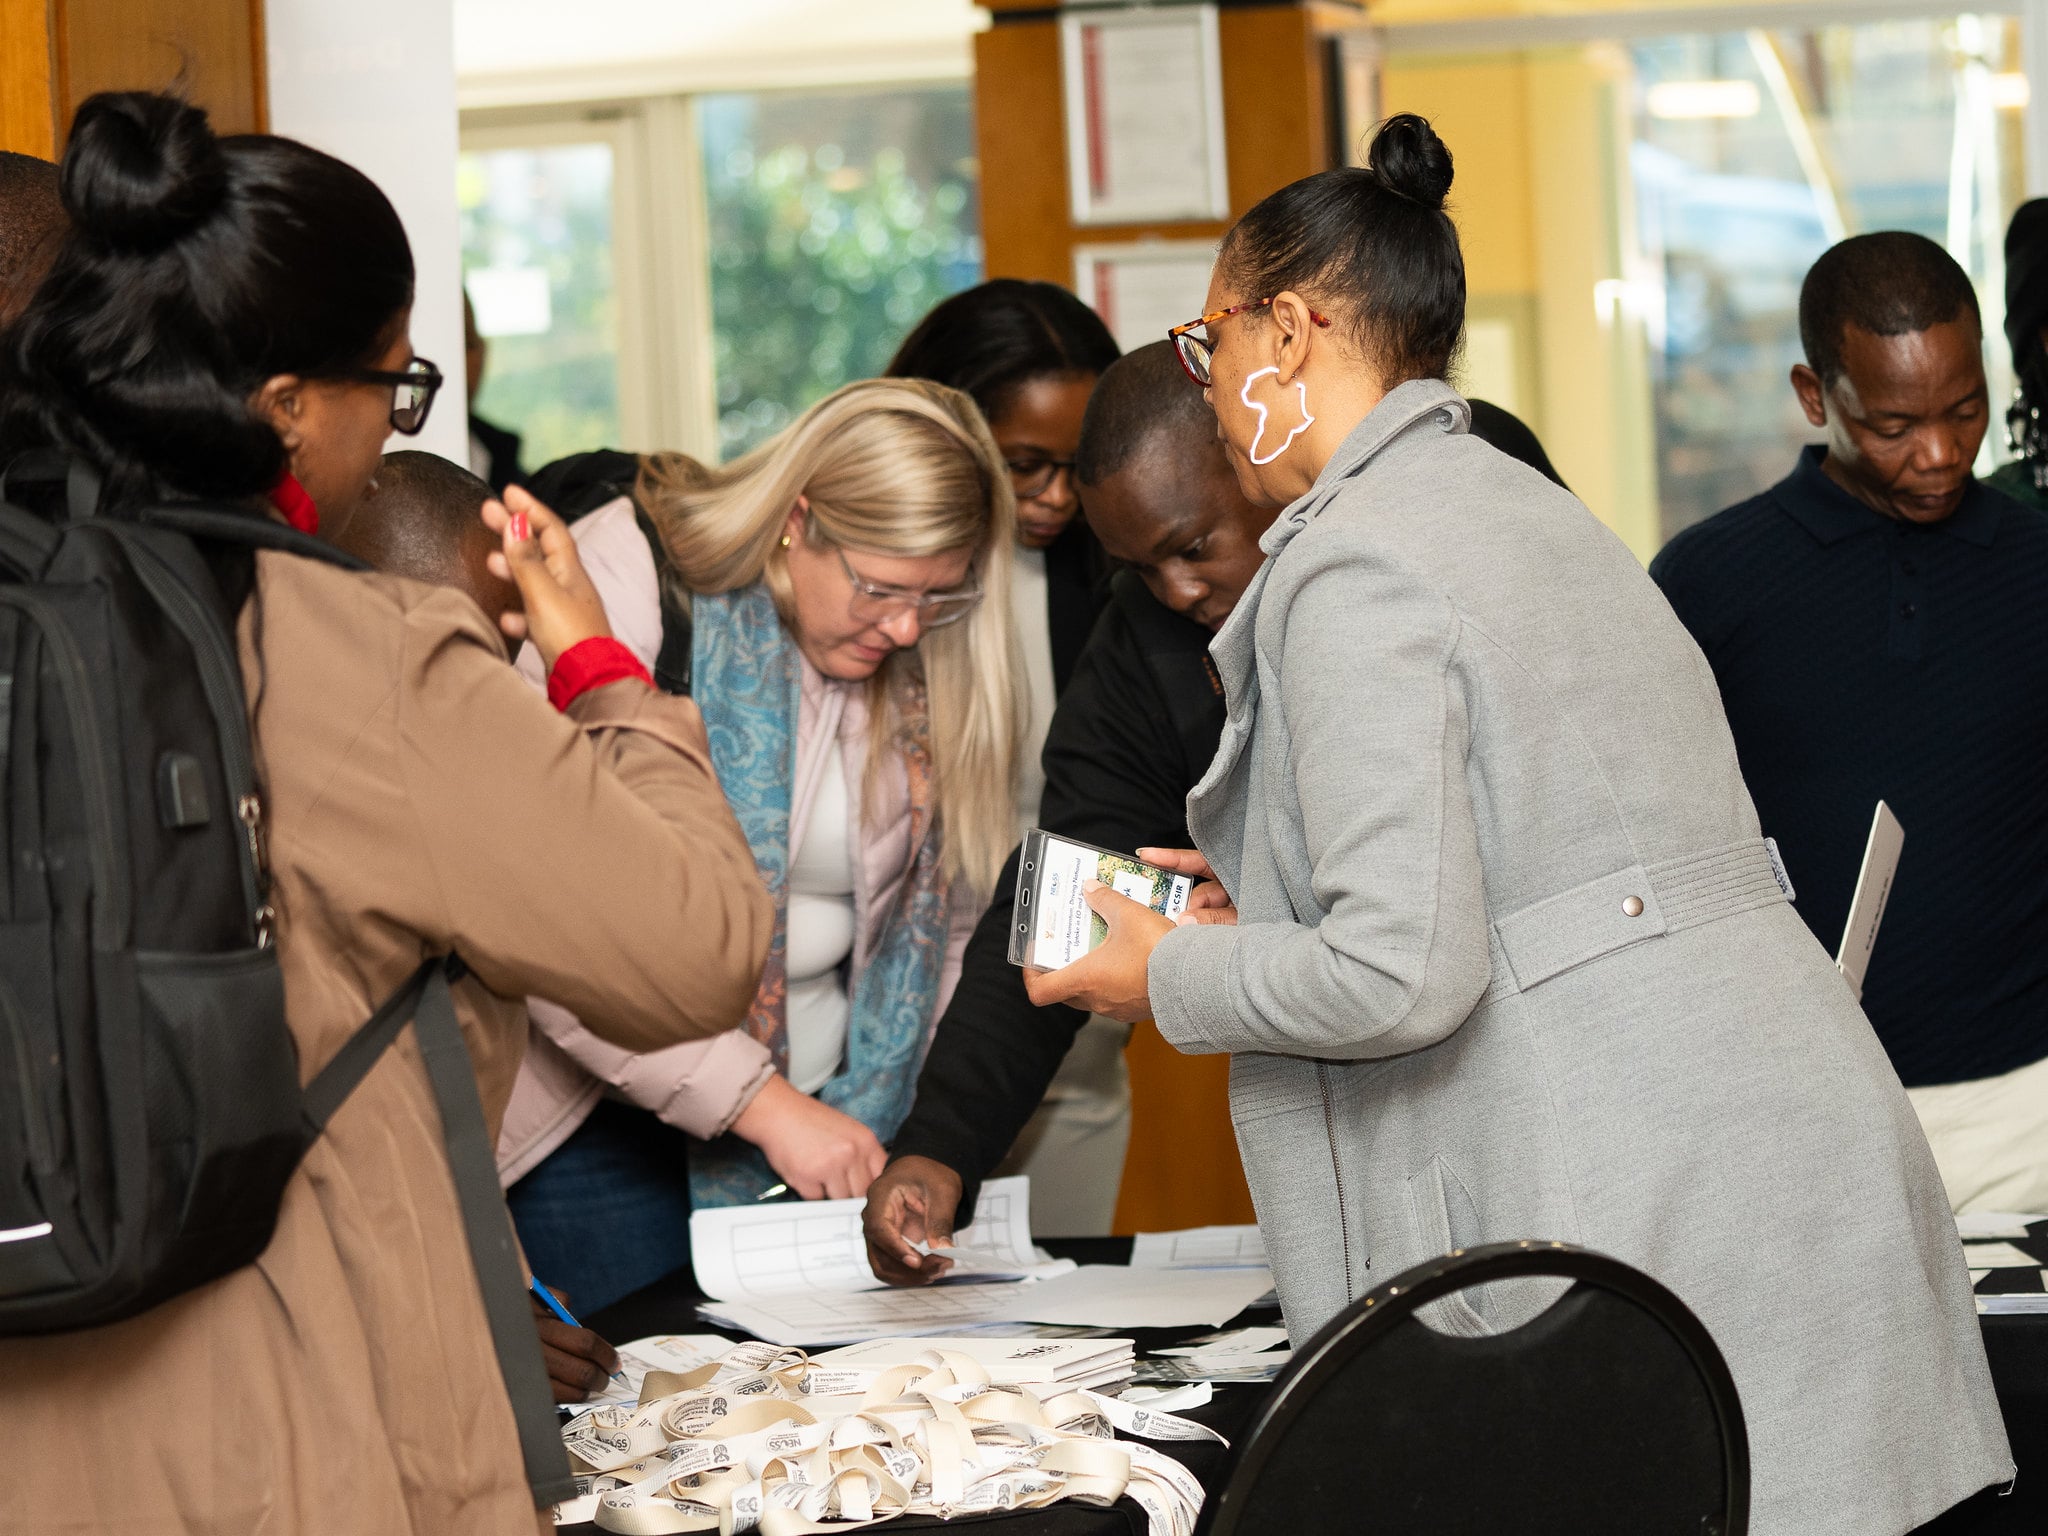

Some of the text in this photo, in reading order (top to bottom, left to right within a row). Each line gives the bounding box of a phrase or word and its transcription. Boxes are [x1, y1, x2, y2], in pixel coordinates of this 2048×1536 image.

[1123, 887, 1132, 898] yk
[1173, 884, 1183, 905] CSIR
[1064, 940, 1072, 962] Building
[1069, 884, 1077, 905] Driving
[1073, 857, 1081, 884] National
